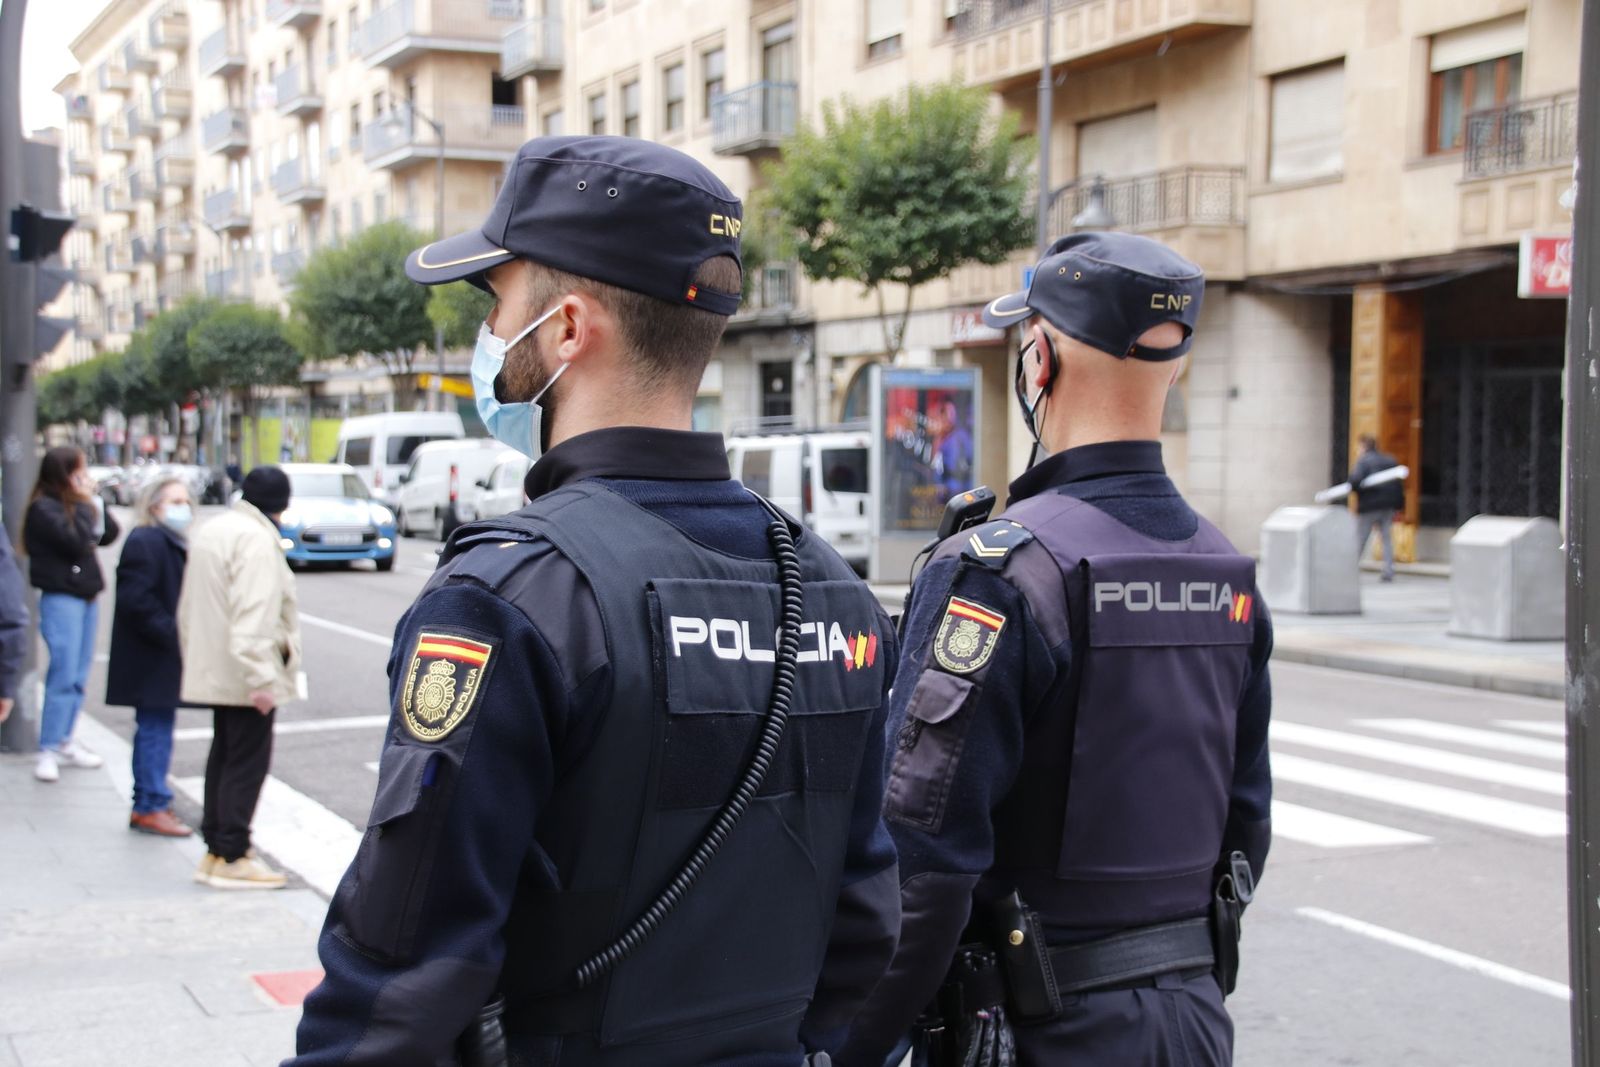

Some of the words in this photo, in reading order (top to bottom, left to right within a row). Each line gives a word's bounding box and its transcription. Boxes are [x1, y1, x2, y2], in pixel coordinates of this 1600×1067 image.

[710, 213, 742, 238] CNP
[1151, 293, 1192, 312] CNP
[1094, 581, 1235, 612] POLICIA
[670, 615, 854, 663] POLCIA
[405, 657, 421, 709] CUERPO
[456, 668, 479, 712] POLICIA
[408, 711, 445, 736] NACIONAL
[444, 712, 460, 728] DE
